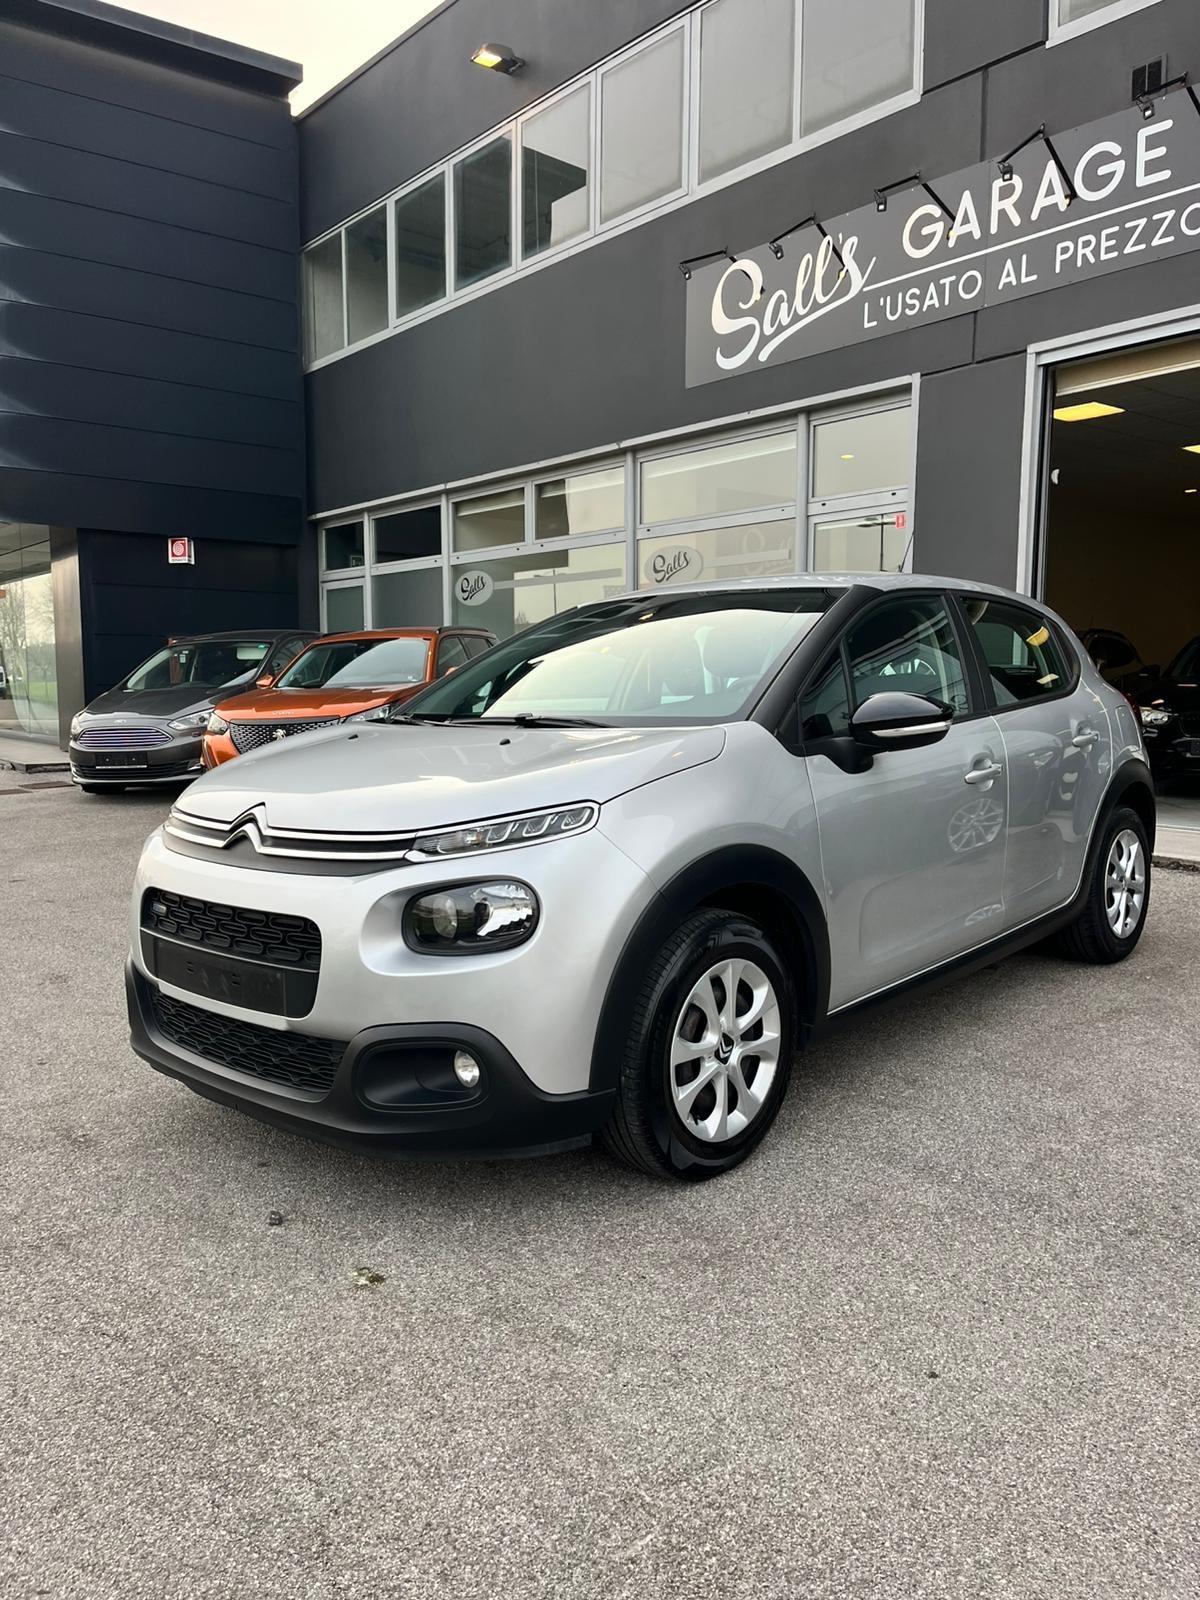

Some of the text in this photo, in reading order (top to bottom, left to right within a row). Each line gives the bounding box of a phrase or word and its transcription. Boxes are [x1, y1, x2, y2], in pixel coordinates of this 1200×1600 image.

[711, 118, 1174, 370] Sall's GARAGE
[863, 202, 1200, 329] L'USATO AL PREZZO
